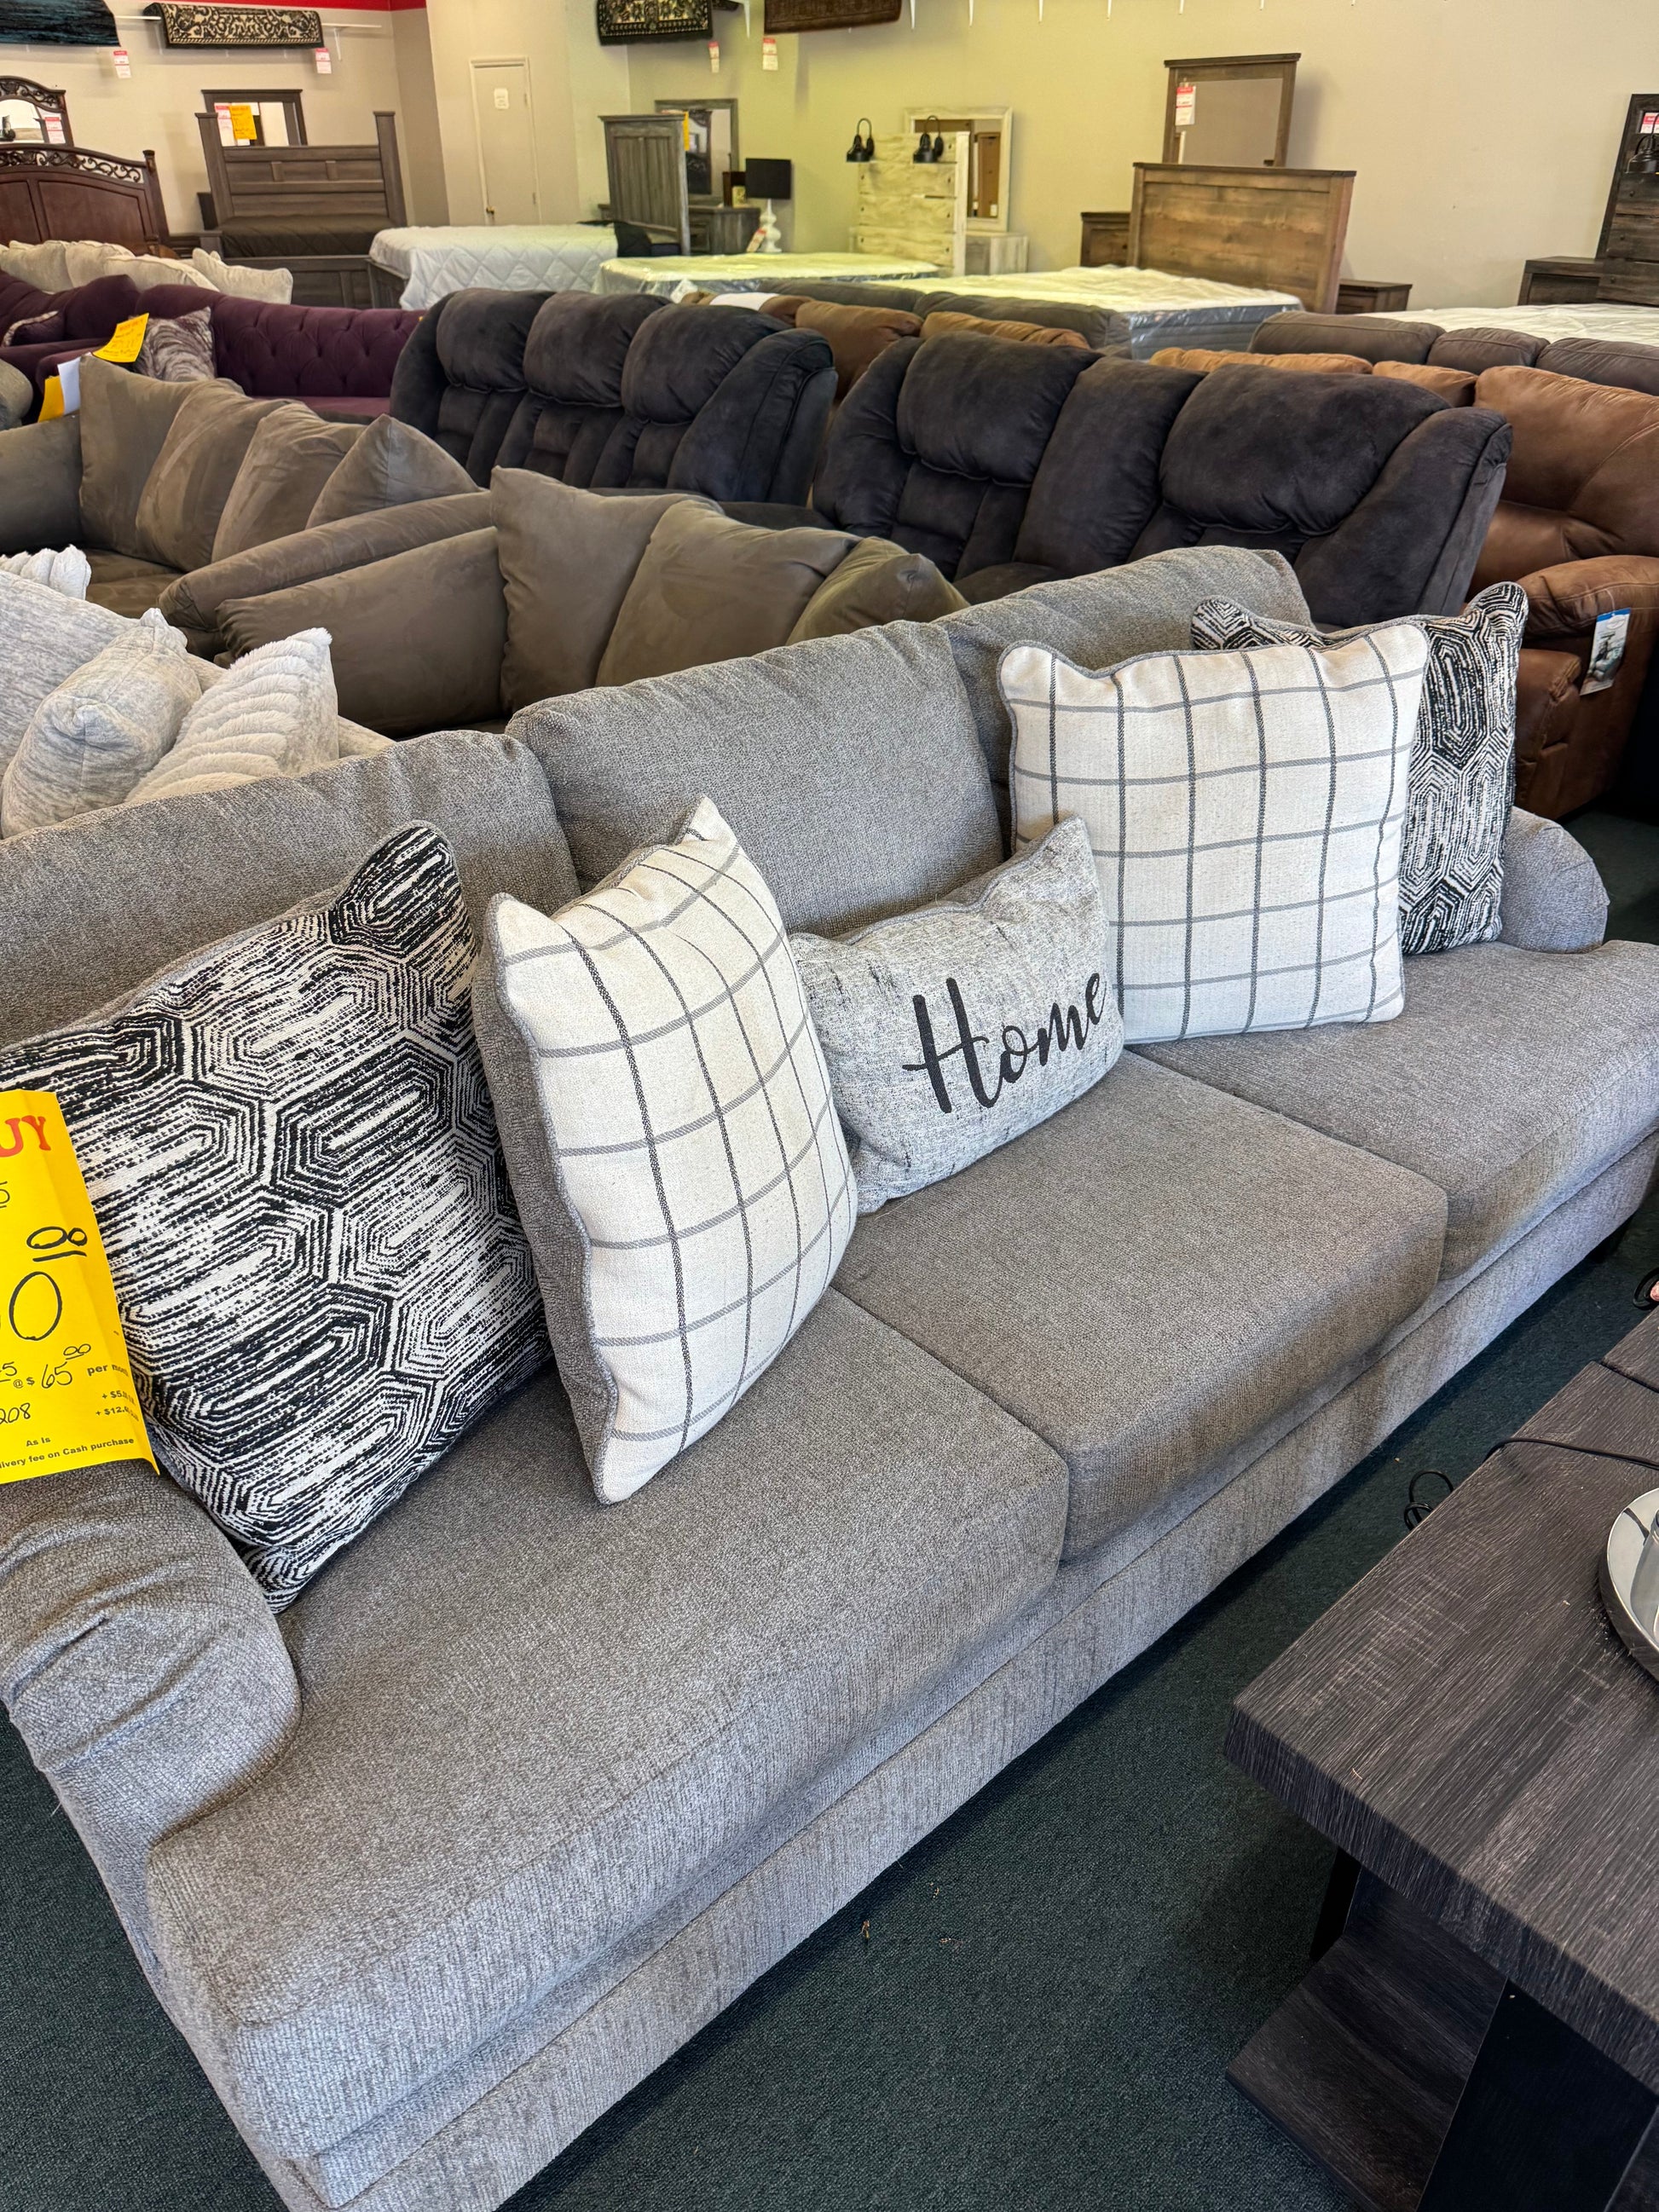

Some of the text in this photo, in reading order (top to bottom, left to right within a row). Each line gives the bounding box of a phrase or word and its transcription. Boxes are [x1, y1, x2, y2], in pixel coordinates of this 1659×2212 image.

[902, 973, 1106, 1113] Home
[87, 1365, 108, 1377] per
[62, 1445, 88, 1455] Cash
[90, 1438, 135, 1451] purchase
